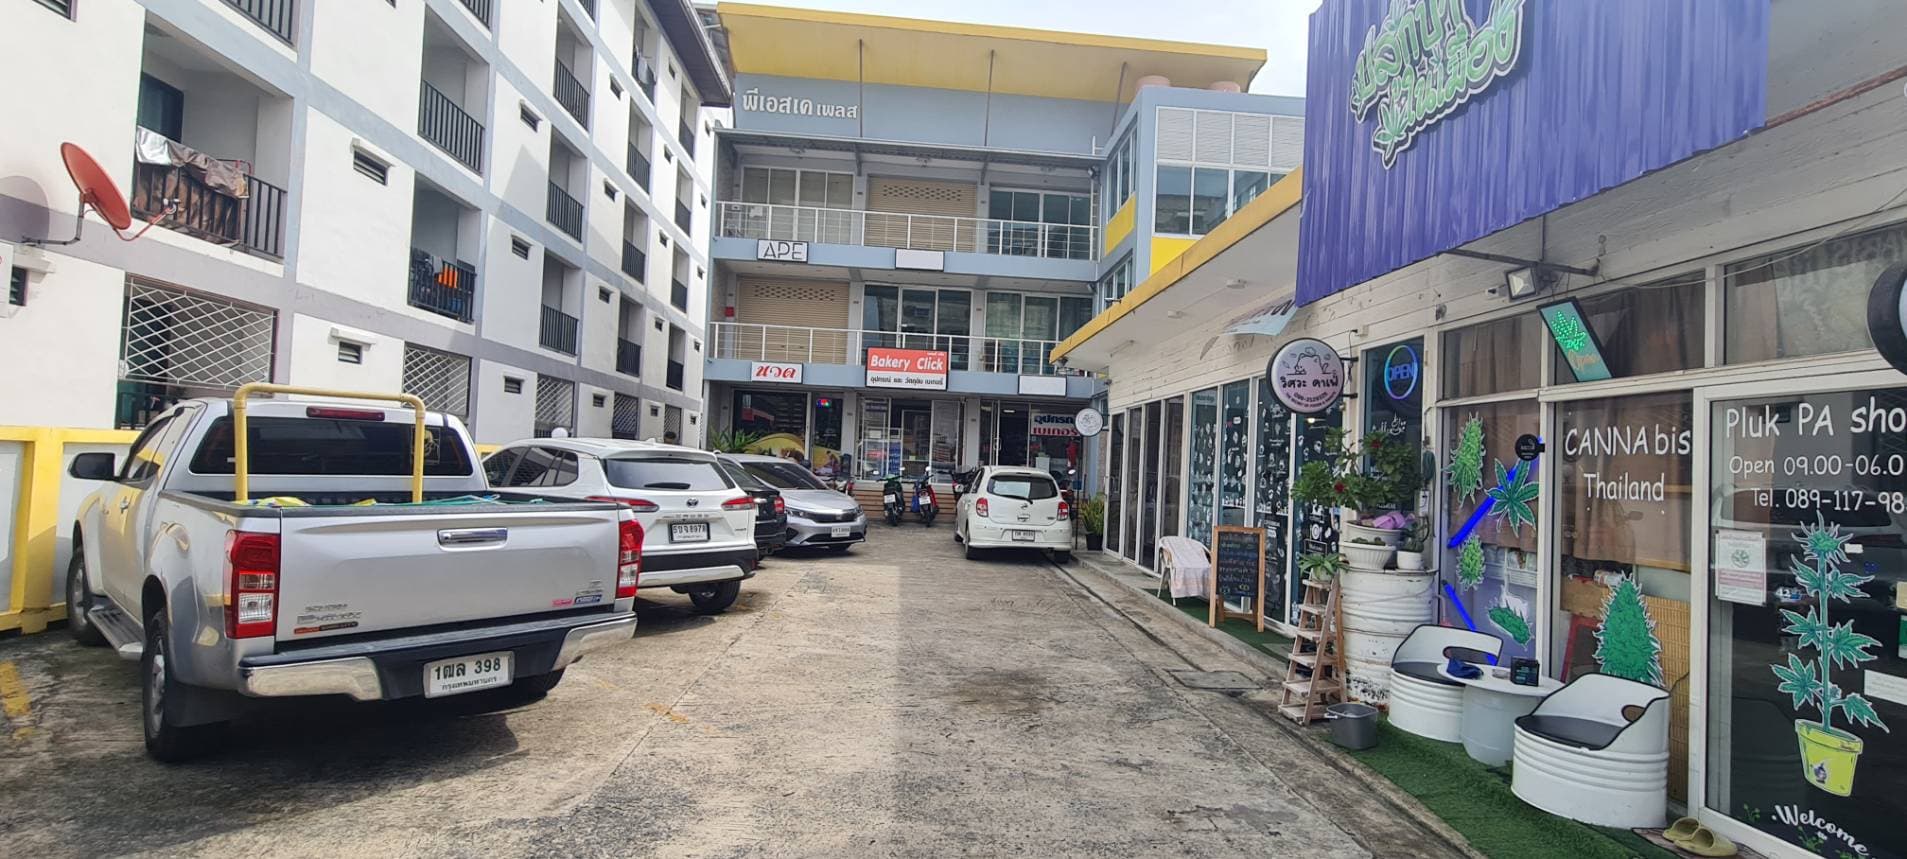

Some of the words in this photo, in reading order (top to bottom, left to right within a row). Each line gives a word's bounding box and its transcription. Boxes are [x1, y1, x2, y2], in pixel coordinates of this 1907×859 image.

[763, 240, 804, 260] APE
[755, 363, 796, 379] นวด
[870, 354, 911, 371] Bakery
[917, 356, 944, 371] Click
[1726, 404, 1781, 438] Pluk
[1798, 402, 1834, 437] PA
[1729, 455, 1775, 480] Open
[1583, 471, 1665, 502] Thailand
[1750, 487, 1780, 508] Tel.
[1785, 488, 1907, 514] 089-117-98
[474, 657, 501, 674] 398
[1774, 804, 1869, 857] Welcome
